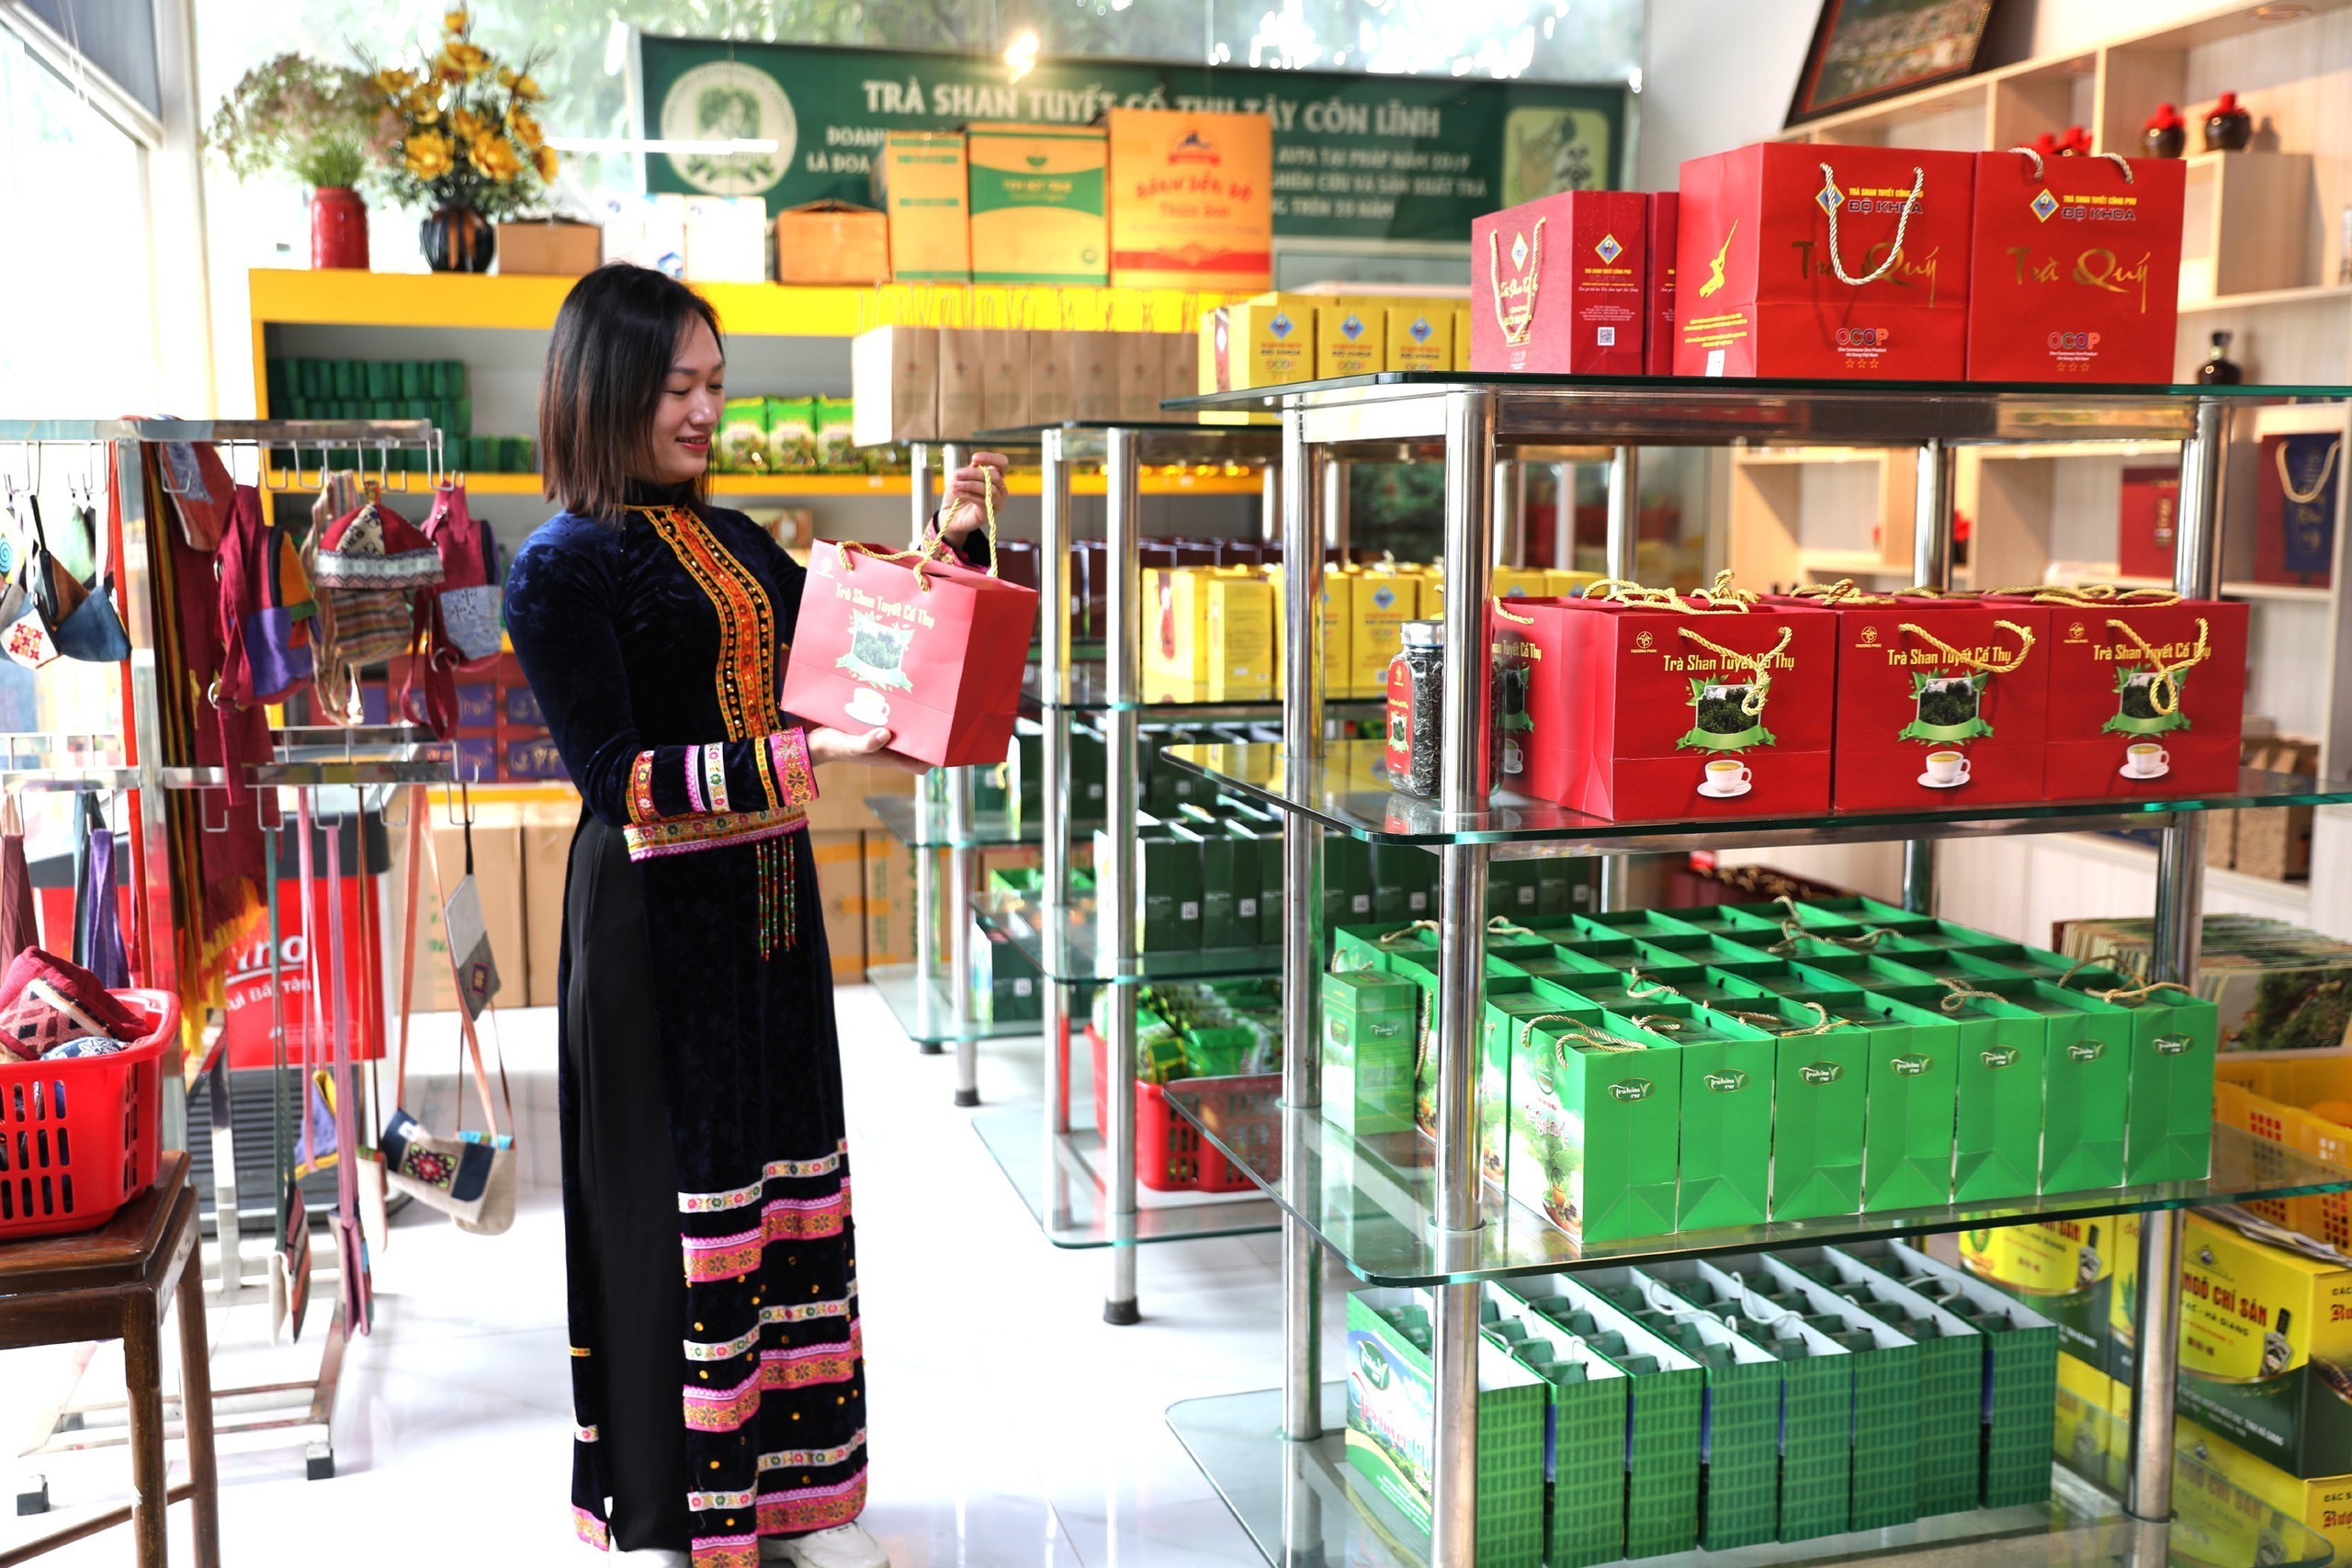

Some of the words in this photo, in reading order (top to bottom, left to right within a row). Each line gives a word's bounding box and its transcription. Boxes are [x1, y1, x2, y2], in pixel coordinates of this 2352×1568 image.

[863, 75, 925, 115] TRÀ
[933, 83, 1018, 118] SHAN
[1304, 96, 1369, 135] CÔN
[806, 149, 829, 173] LÀ
[832, 151, 871, 175] DOA
[2089, 207, 2137, 221] KHOA
[2006, 246, 2060, 285] Trà
[2073, 248, 2152, 314] Quý
[1836, 328, 1889, 346] OCOP
[2047, 332, 2101, 350] OCOP
[1887, 647, 1907, 665] Trà
[1910, 649, 1939, 665] Shan
[1976, 646, 1990, 663] Cổ
[1992, 646, 2012, 664] Thụ
[2093, 645, 2112, 660] Trà
[2115, 644, 2141, 660] Shan
[2176, 641, 2189, 658] Cổ
[1663, 655, 1683, 671] Trà
[1687, 655, 1716, 671] Shan
[1775, 653, 1794, 671] Thụ
[2212, 1286, 2236, 1313] CHÍ
[2240, 1297, 2267, 1327] SÁN
